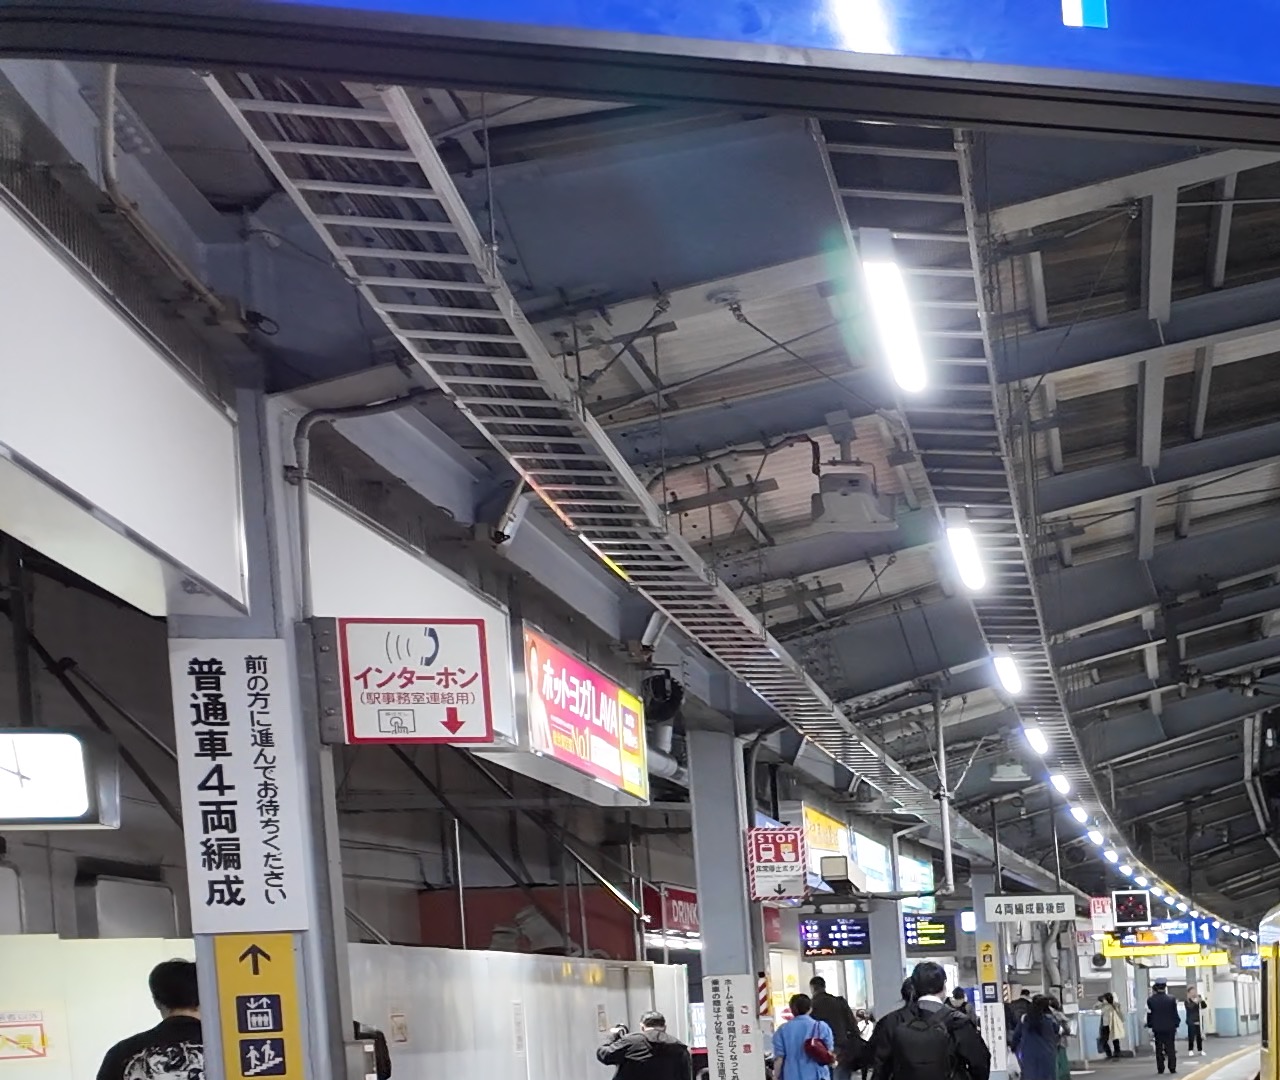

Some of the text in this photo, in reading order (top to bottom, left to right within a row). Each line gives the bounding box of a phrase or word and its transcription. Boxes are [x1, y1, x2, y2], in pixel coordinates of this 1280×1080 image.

[354, 666, 479, 690] インターホン
[187, 657, 247, 907] 普通車4両編成
[245, 655, 287, 905] 前の方に進んでお待ちください
[757, 833, 796, 844] STOP
[756, 863, 801, 873] 非常停止ボタン
[1199, 923, 1210, 940] 1
[741, 1005, 752, 1054] ご注意
